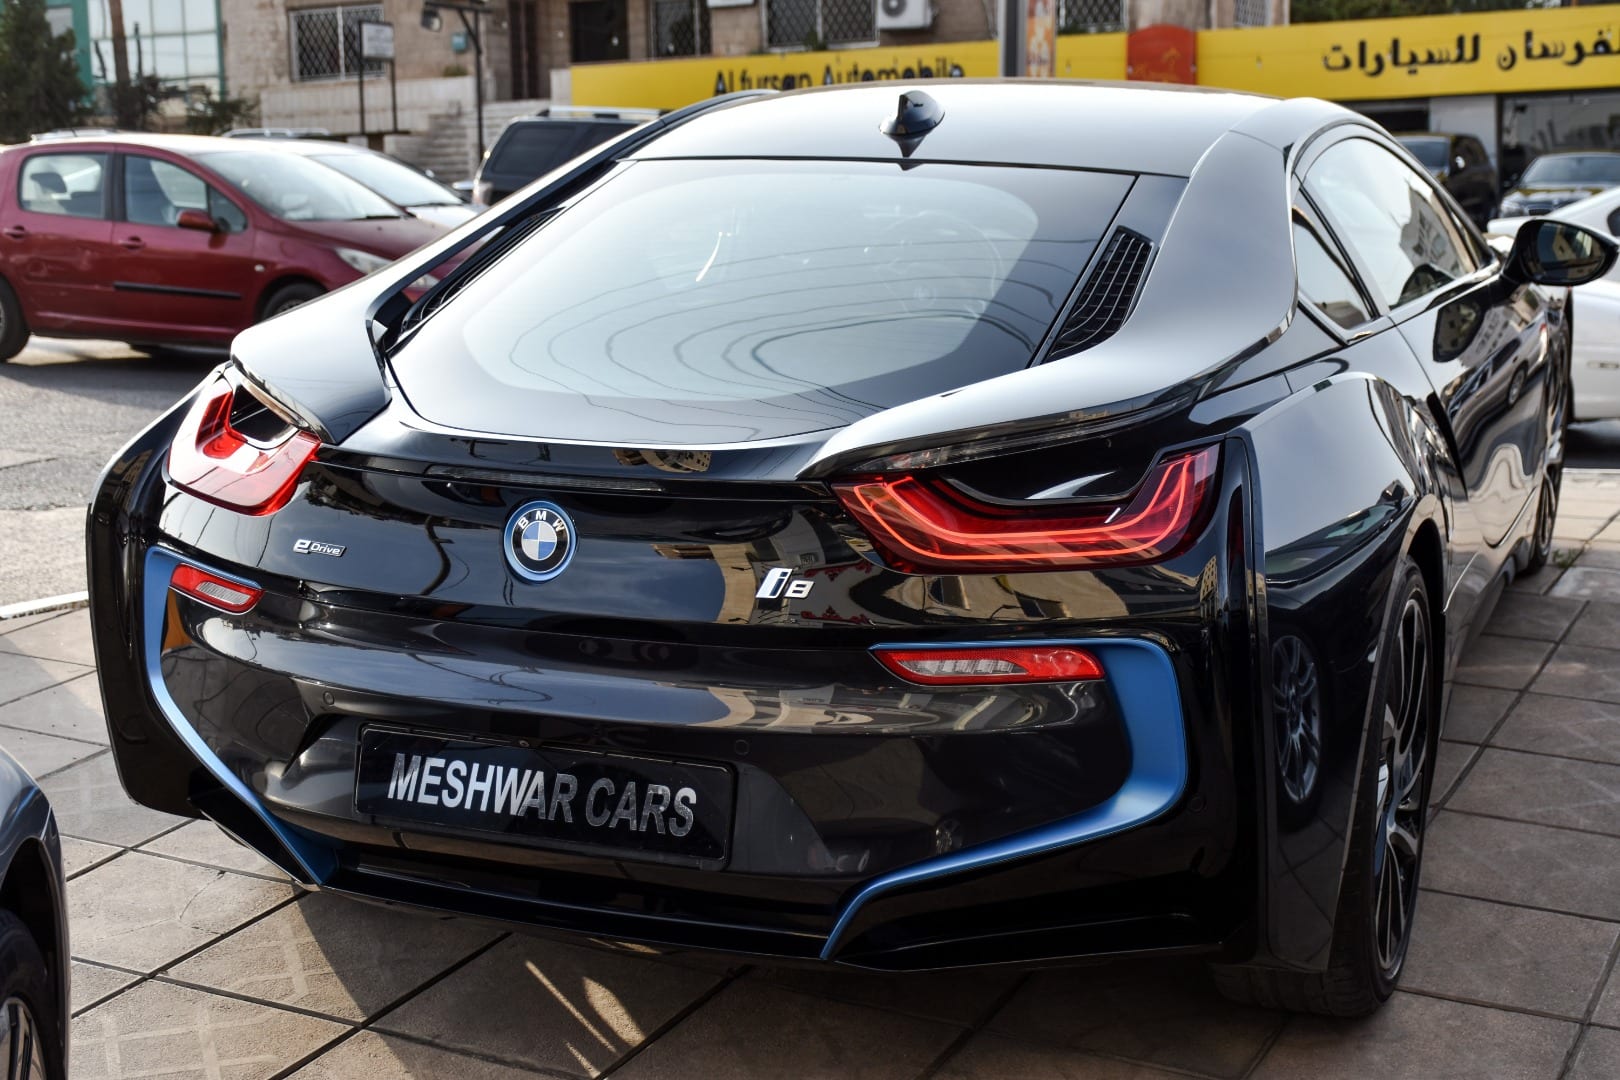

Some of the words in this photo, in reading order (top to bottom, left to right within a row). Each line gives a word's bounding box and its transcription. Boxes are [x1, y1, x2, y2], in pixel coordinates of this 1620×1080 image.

[1322, 33, 1481, 77] للسيارات
[1498, 29, 1620, 71] فرسان
[517, 510, 565, 532] BMW
[755, 567, 815, 599] i8
[387, 753, 579, 824] MESHWAR
[585, 777, 697, 837] CARS
